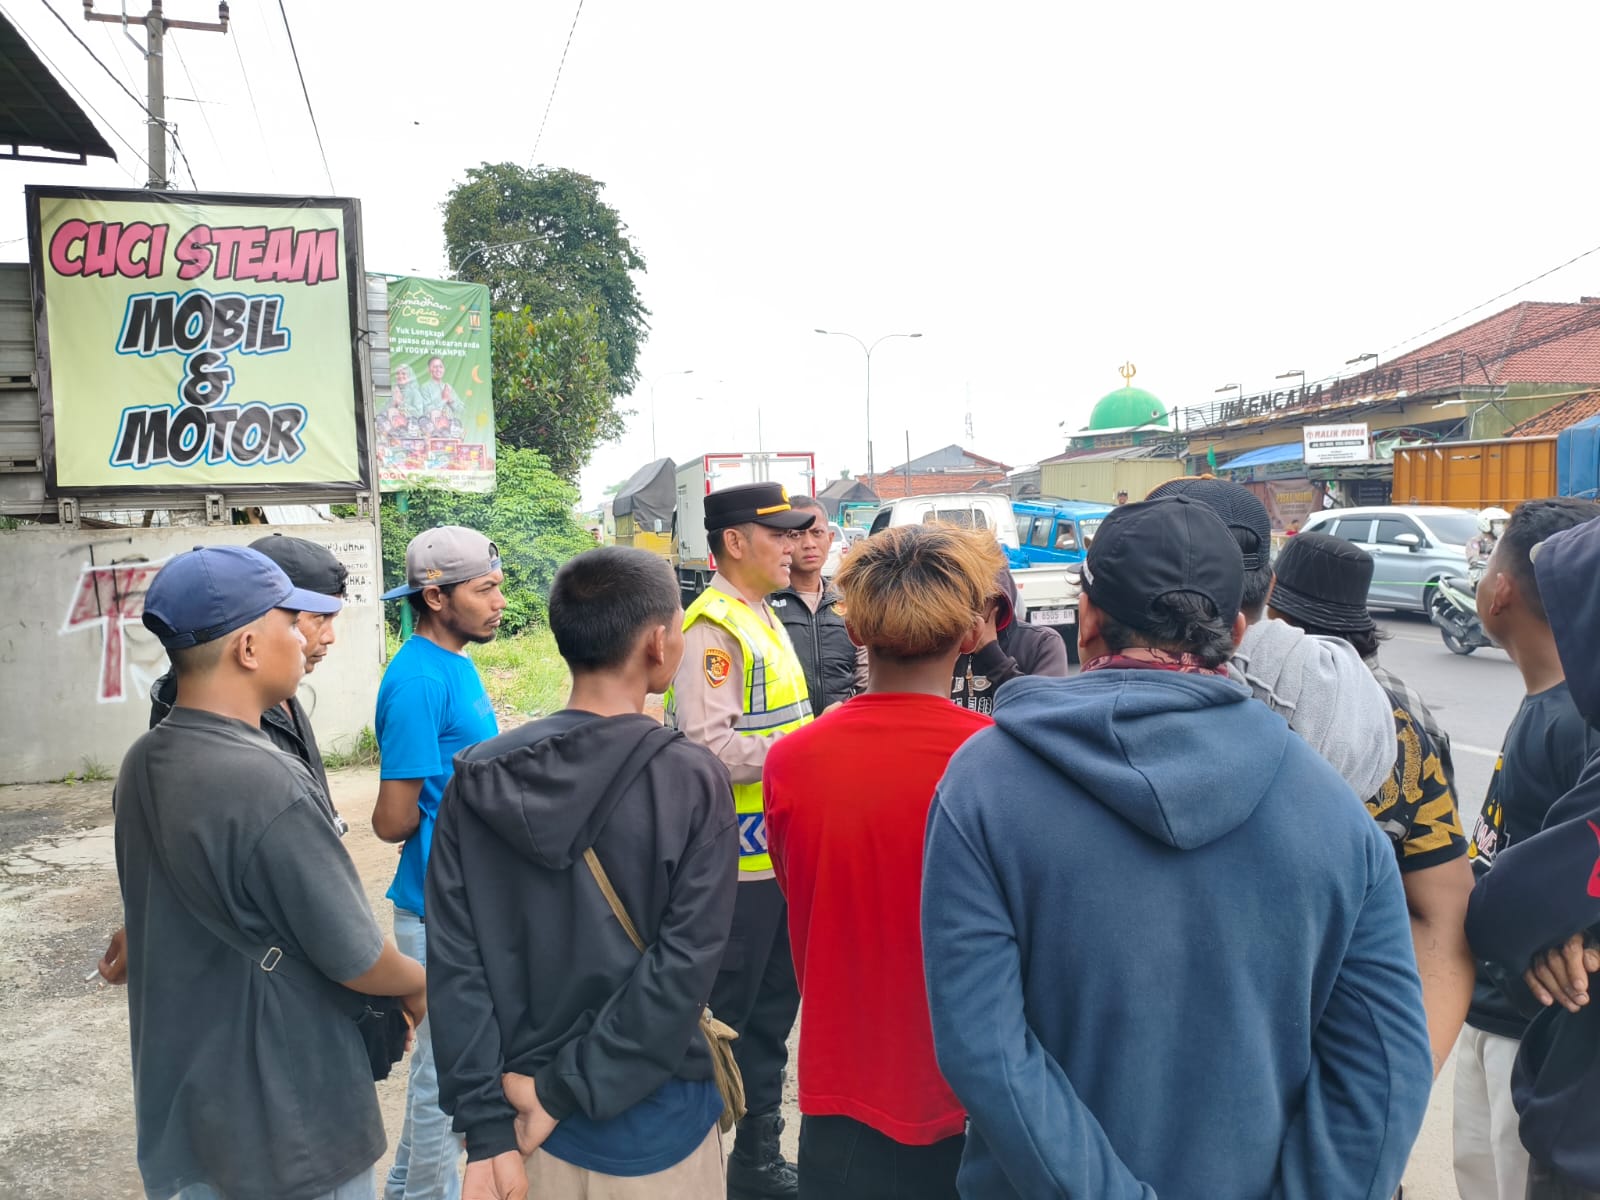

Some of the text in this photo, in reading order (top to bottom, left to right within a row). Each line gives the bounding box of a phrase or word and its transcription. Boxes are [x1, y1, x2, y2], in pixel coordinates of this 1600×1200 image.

[49, 218, 340, 285] CUCI STEAM
[117, 290, 290, 355] MOBIL
[180, 351, 235, 407] &
[111, 404, 308, 468] MOTOR
